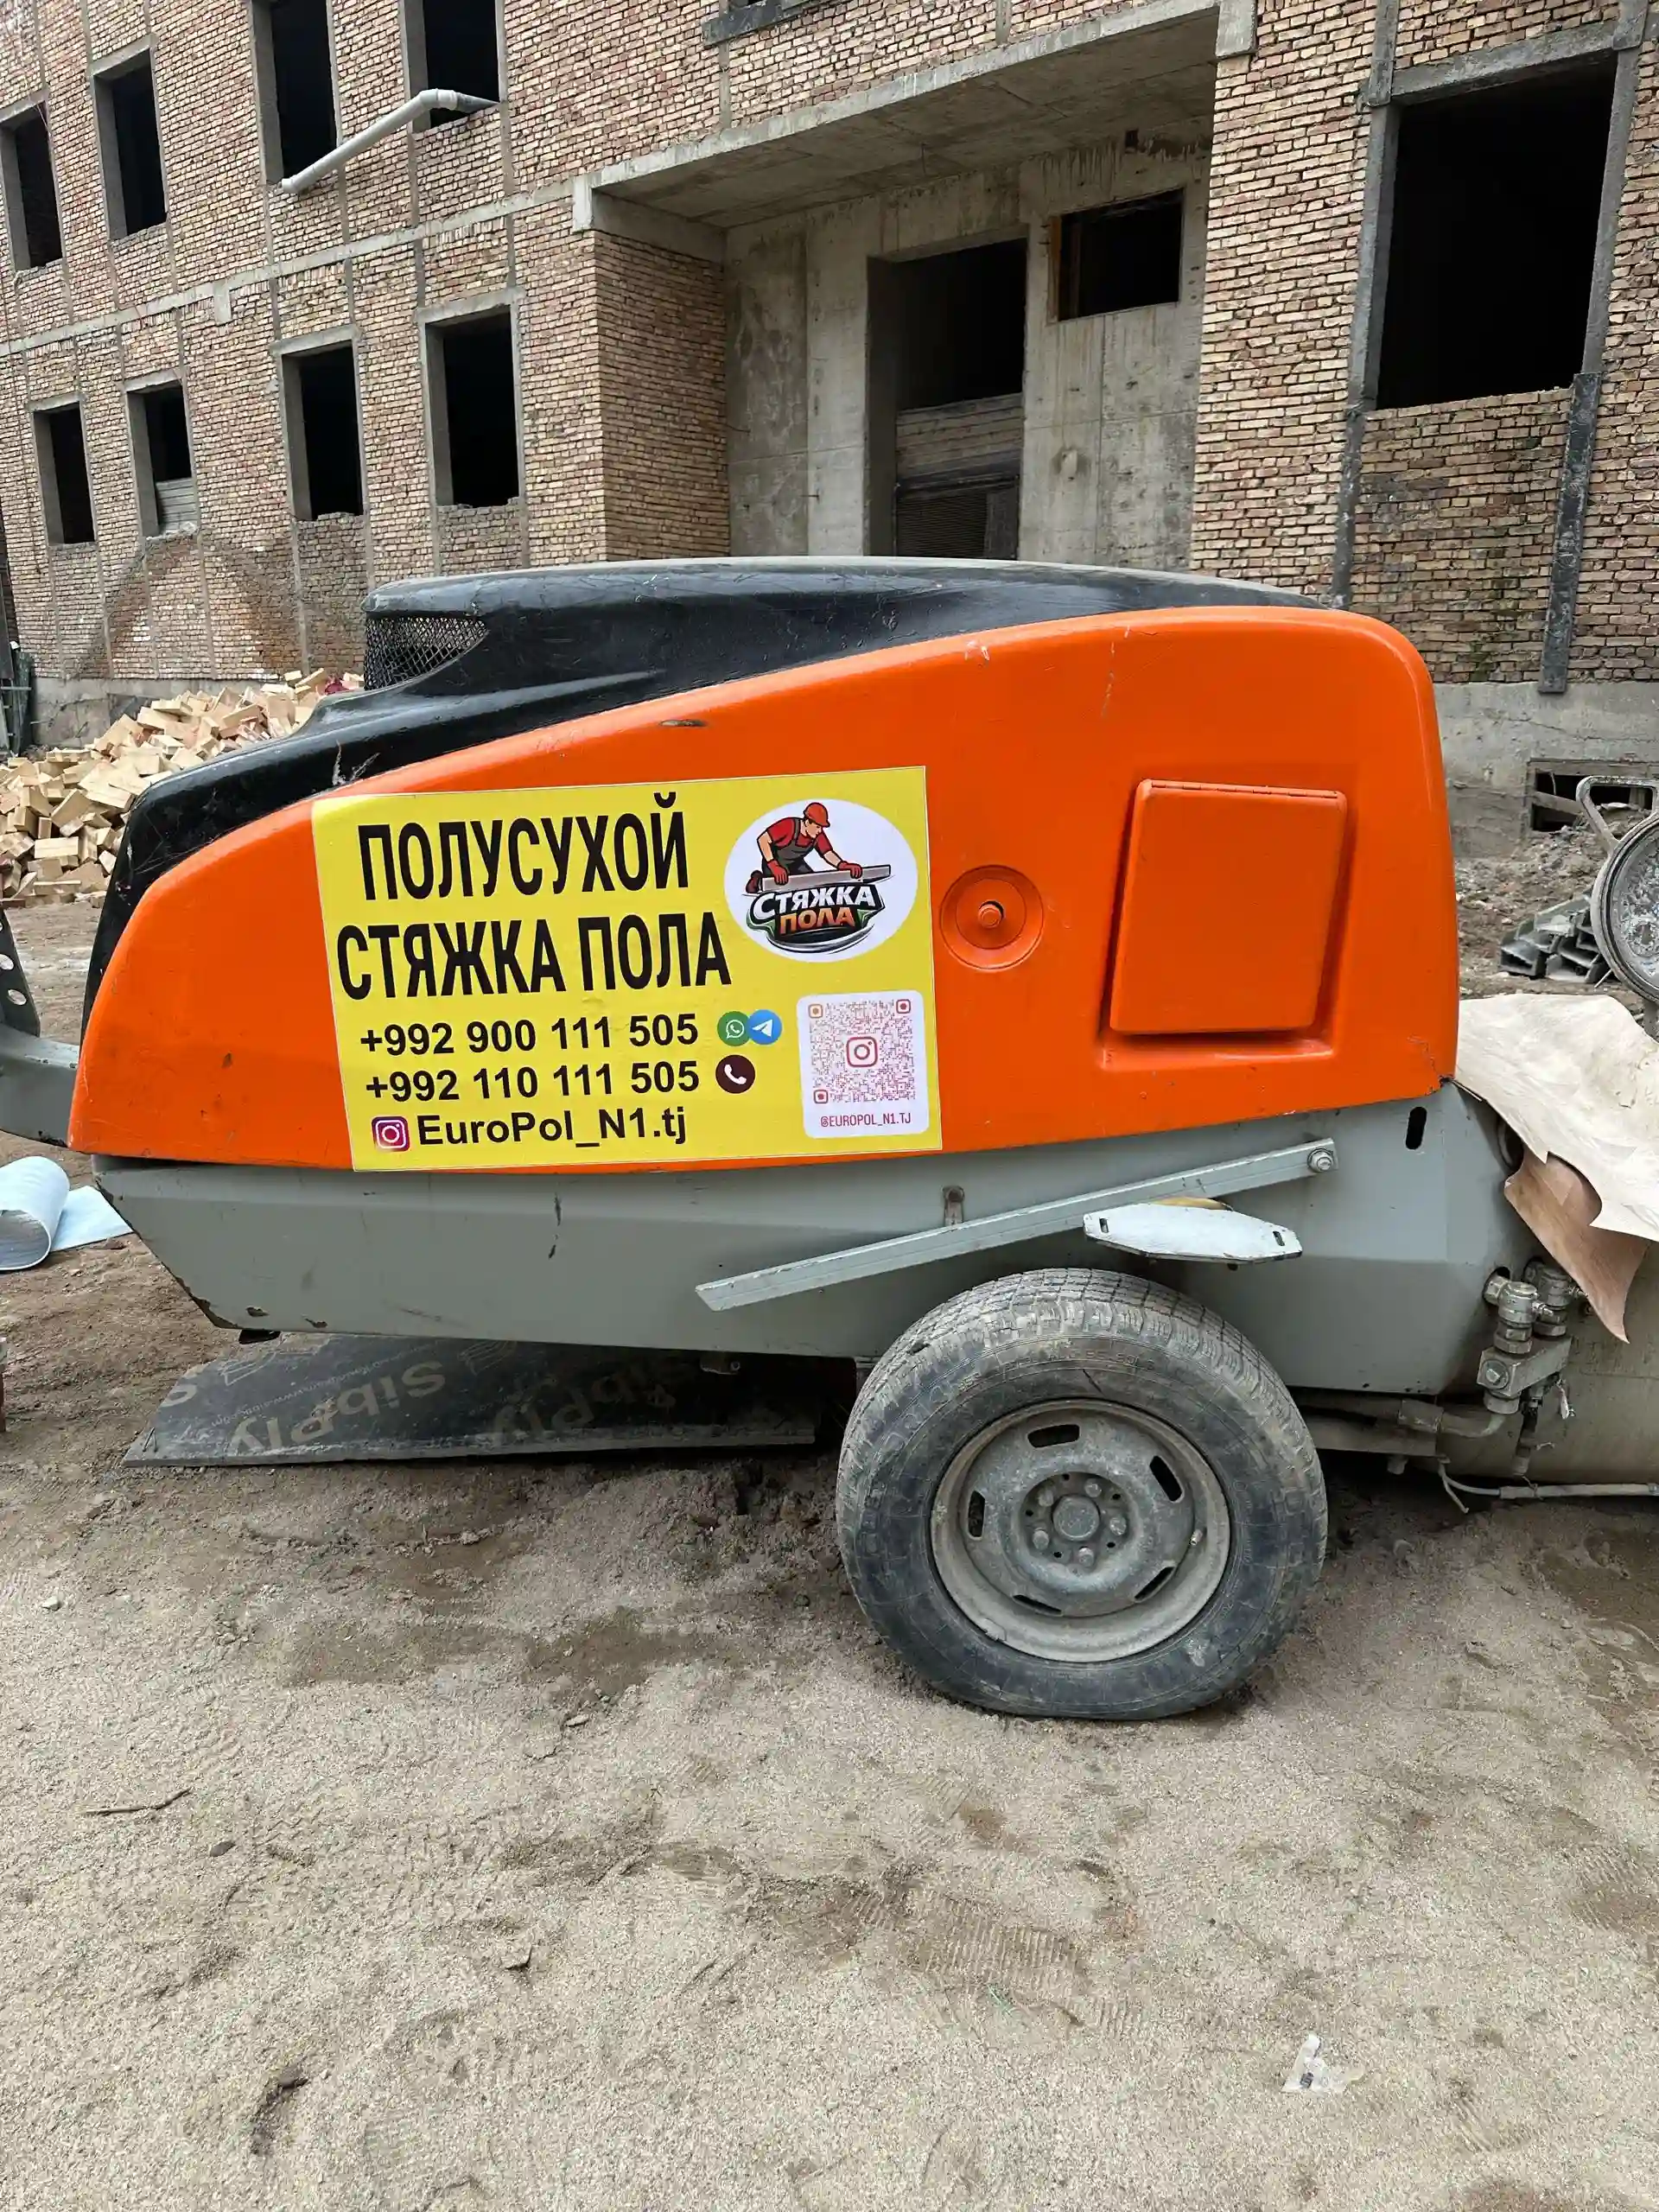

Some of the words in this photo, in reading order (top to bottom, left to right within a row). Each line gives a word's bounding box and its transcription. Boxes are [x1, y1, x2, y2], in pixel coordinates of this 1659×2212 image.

[358, 791, 689, 900] ПОЛУСУХОЙ
[751, 885, 876, 919] СТЯЖКА
[780, 906, 856, 935] ПОЛА
[337, 919, 567, 1001] СТЯЖКА
[576, 912, 732, 991] ПОЛА
[359, 1023, 454, 1056] +992
[467, 1020, 536, 1053] 900
[551, 1016, 610, 1050] 111
[629, 1013, 698, 1047] 505
[365, 1070, 459, 1103] +992
[473, 1066, 538, 1099] 110
[553, 1063, 612, 1096] 111
[630, 1060, 699, 1094] 505
[416, 1106, 686, 1148] EuroPol_N1.tj
[820, 1112, 911, 1128] @EUROPOL_N1.TJ
